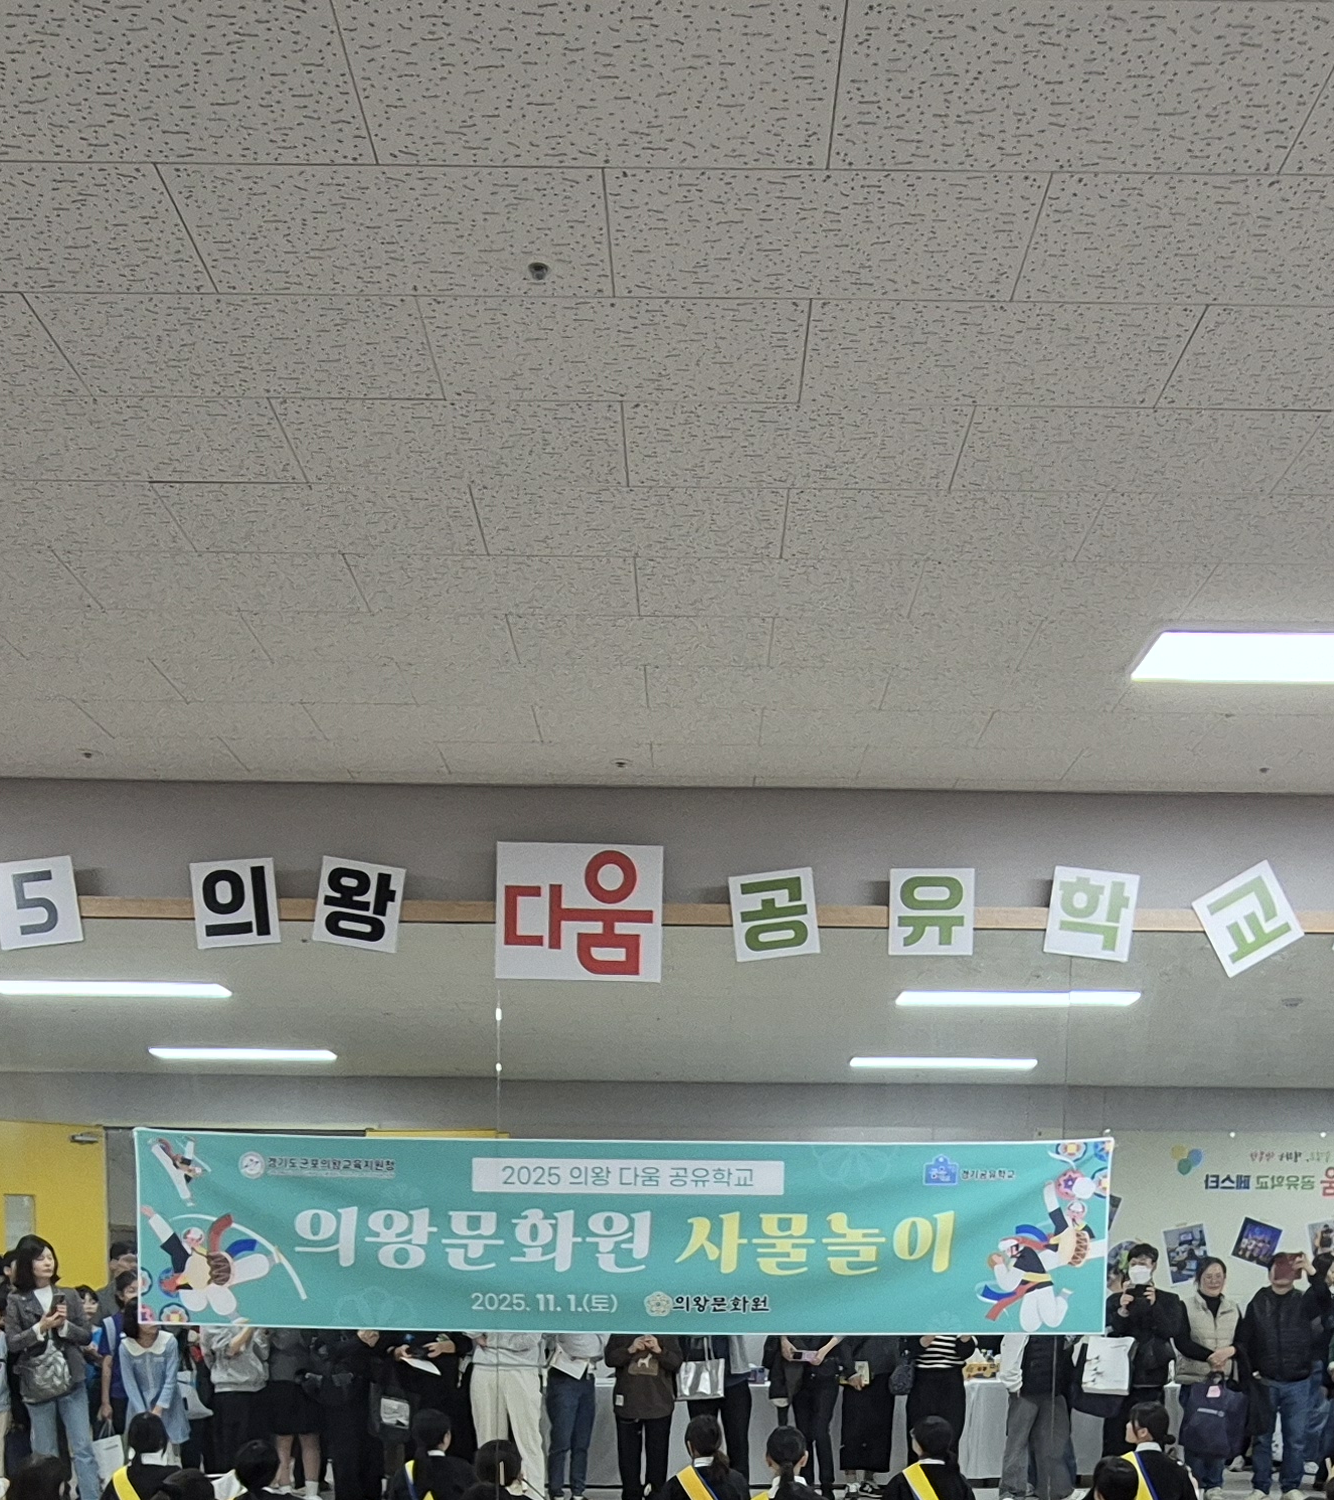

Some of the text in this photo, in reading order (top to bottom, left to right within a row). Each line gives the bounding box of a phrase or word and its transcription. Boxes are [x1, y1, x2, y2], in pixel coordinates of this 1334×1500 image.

[503, 849, 654, 976] 다움
[501, 1165, 754, 1188] 2025 의왕 다움 공유학교
[293, 1205, 956, 1276] 의왕문화원 사물놀이
[470, 1292, 530, 1312] 2025.
[535, 1293, 562, 1312] 11.
[671, 1295, 770, 1313] 의왕문화원
